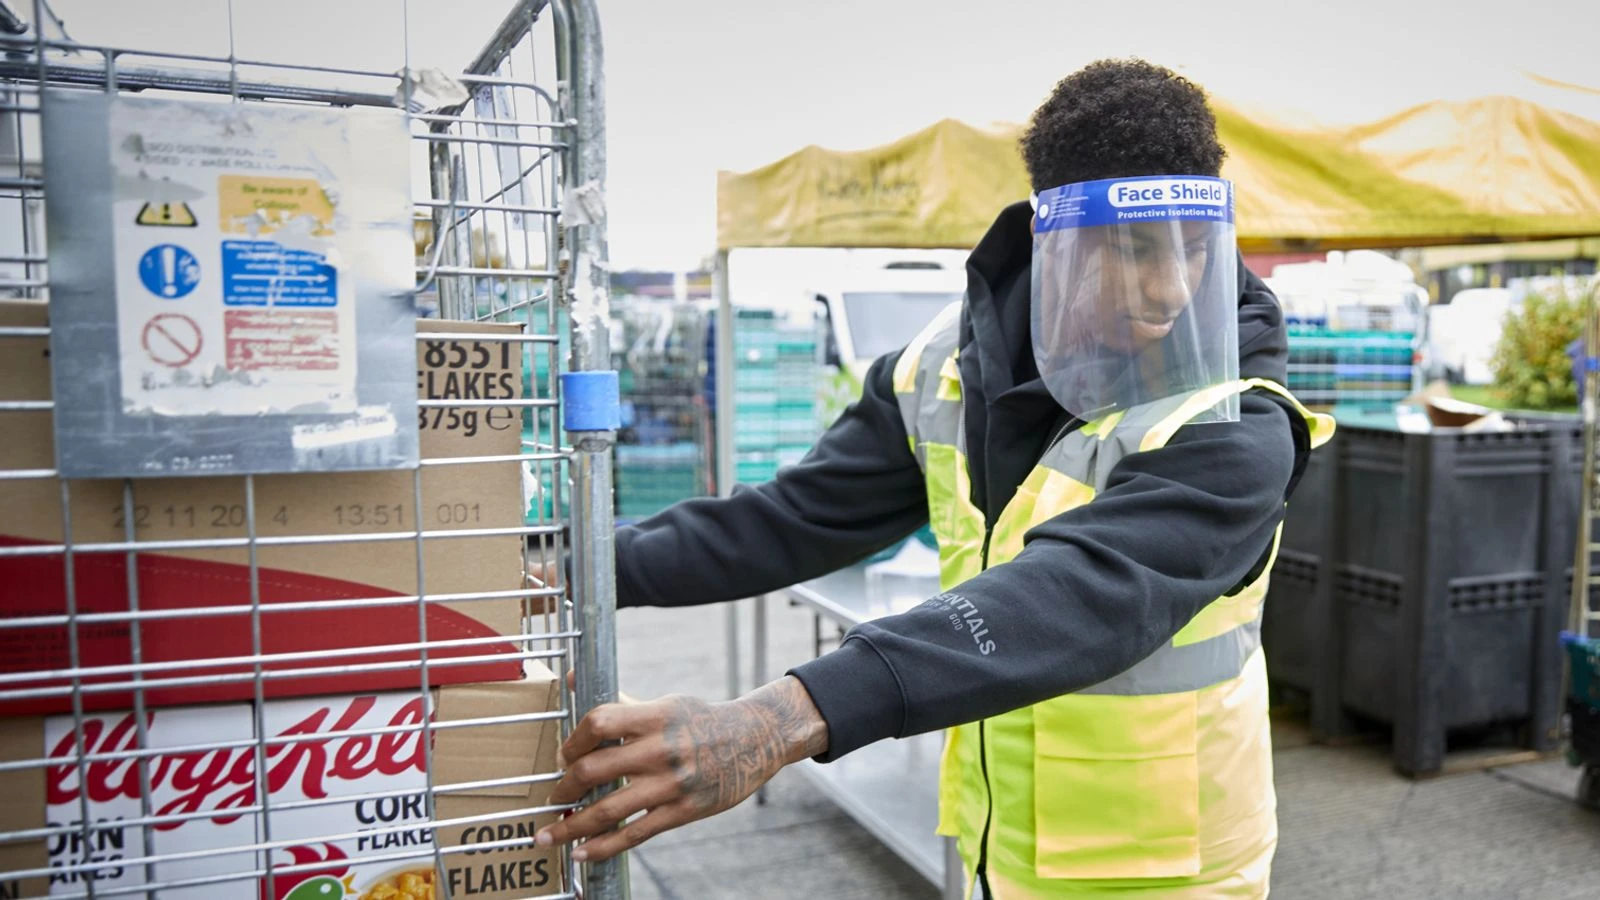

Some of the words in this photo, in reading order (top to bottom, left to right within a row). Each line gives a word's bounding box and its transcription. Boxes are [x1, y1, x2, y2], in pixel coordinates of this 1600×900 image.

[1117, 187, 1164, 203] Face
[1169, 184, 1222, 201] Shield
[1117, 209, 1166, 219] Protective
[1168, 208, 1205, 217] Isolation
[1207, 209, 1224, 217] Mask
[164, 504, 196, 528] 11
[210, 504, 246, 528] 20
[272, 504, 289, 527] 4
[334, 503, 404, 526] 13:51
[436, 502, 481, 525] 001
[460, 821, 535, 856] CORN
[447, 858, 549, 896] FLAKES
